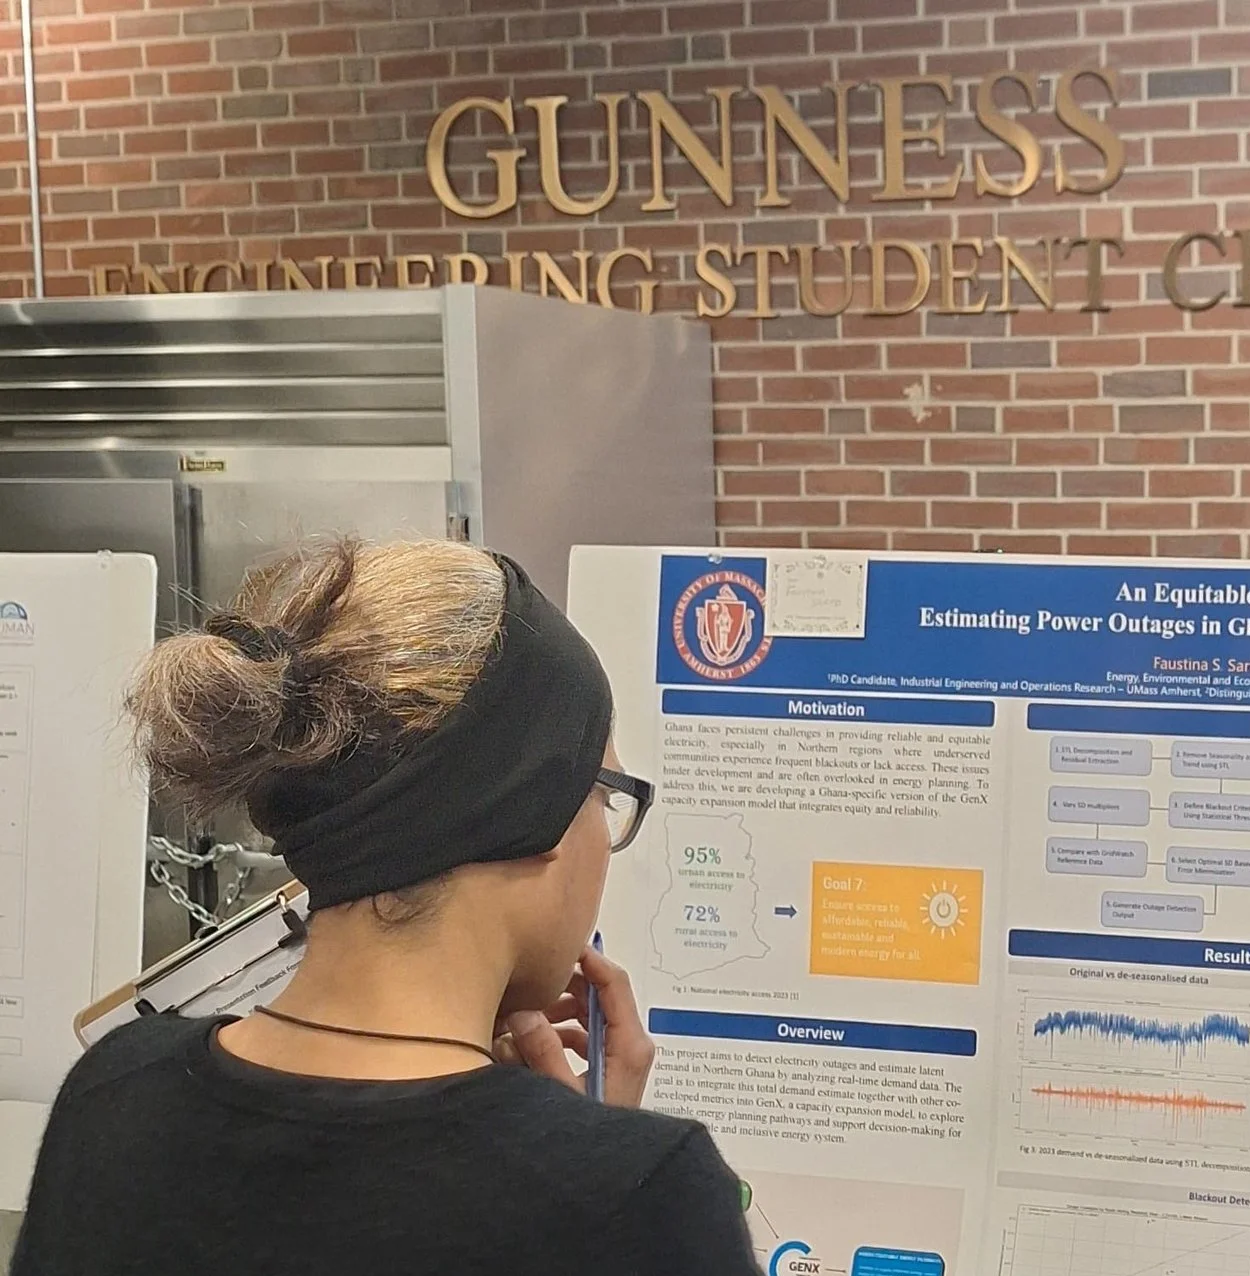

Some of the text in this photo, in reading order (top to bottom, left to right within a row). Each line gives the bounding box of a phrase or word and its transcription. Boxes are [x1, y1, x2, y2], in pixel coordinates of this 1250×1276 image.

[426, 66, 1126, 219] GUNNESS
[697, 236, 1125, 319] STUDENT
[1117, 582, 1145, 601] An
[919, 607, 1031, 633] Estimating
[1037, 610, 1103, 630] Power
[1108, 613, 1195, 638] Outages
[1201, 615, 1221, 634] in
[686, 653, 735, 679] AMHERST
[1153, 656, 1208, 670] Faustina
[850, 674, 897, 685] Candidate,
[901, 676, 942, 686] Industrial
[945, 678, 997, 691] Engineering
[1000, 680, 1018, 689] and
[1020, 680, 1071, 691] Operations
[1074, 682, 1115, 693] Research
[1160, 686, 1201, 696] Amherst,
[1106, 671, 1140, 685] Energy,
[1143, 673, 1210, 687] Environmental
[1212, 675, 1231, 688] and
[788, 700, 864, 715] Motivation
[664, 722, 990, 745] Ghana faces persistent challenges in providing reliable and equitable
[720, 740, 764, 752] especially
[778, 741, 786, 750] in
[798, 742, 837, 752] Northern
[849, 747, 882, 756] regions
[894, 746, 921, 756] where
[934, 749, 990, 759] underserved
[684, 846, 722, 865] 95%
[689, 880, 733, 891] electricity
[823, 877, 867, 892] Goal 7:
[683, 905, 721, 924] 72%
[1069, 968, 1103, 978] Original
[1189, 975, 1208, 984] data
[777, 1023, 844, 1040] Overview
[656, 1046, 676, 1057] This
[677, 1050, 707, 1060] project
[734, 1053, 742, 1061] to
[745, 1052, 771, 1063] detect
[775, 1055, 819, 1067] electricity
[822, 1060, 856, 1071] outages
[859, 1062, 876, 1070] and
[879, 1065, 916, 1074] estimate
[919, 1065, 944, 1076] latent
[655, 1061, 690, 1073] demand
[704, 1064, 743, 1075] Northern
[745, 1067, 775, 1078] Ghana
[777, 1069, 789, 1081] by
[791, 1072, 835, 1084] analyzing
[838, 1075, 878, 1085] real-time
[881, 1077, 917, 1088] demand
[945, 1082, 962, 1092] The
[1189, 1192, 1226, 1203] Blackout
[789, 1261, 820, 1274] GENX
